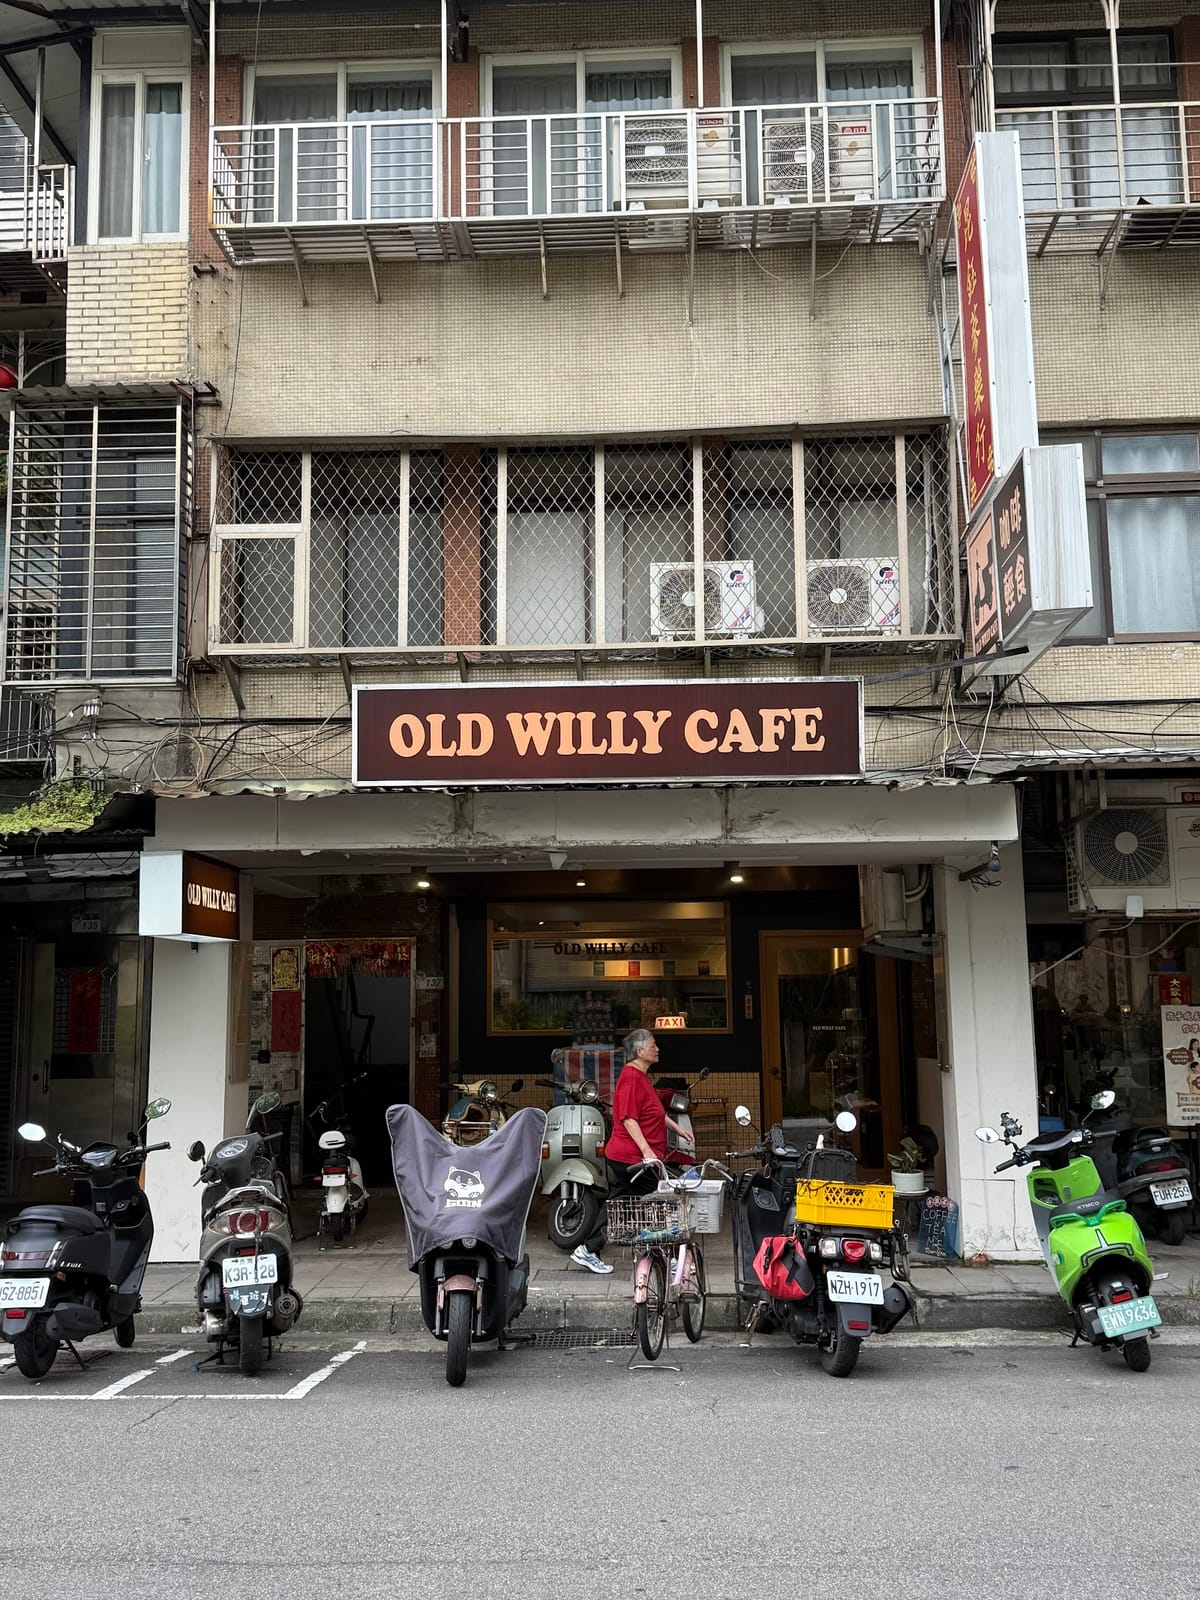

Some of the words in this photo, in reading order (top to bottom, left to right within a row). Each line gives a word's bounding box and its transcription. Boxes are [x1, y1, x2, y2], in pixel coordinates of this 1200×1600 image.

[1000, 485, 1022, 550] 咖啡
[1003, 554, 1027, 617] 輕食
[389, 713, 495, 758] OLD
[506, 710, 672, 757] WILLY
[684, 707, 826, 754] CAFE
[187, 882, 201, 906] OLD
[201, 886, 221, 910] WILLY
[221, 891, 237, 912] CAFE
[553, 943, 581, 955] OLD
[584, 943, 628, 955] WILLY
[631, 942, 668, 954] CAFE
[424, 978, 442, 987] 137
[657, 1018, 683, 1027] TAXI
[1077, 1201, 1100, 1210] KYMCO
[923, 1208, 958, 1223] COFFEE
[925, 1223, 946, 1236] TEA
[0, 1286, 44, 1301] SZ-8851
[830, 1280, 880, 1297] NZH-1917
